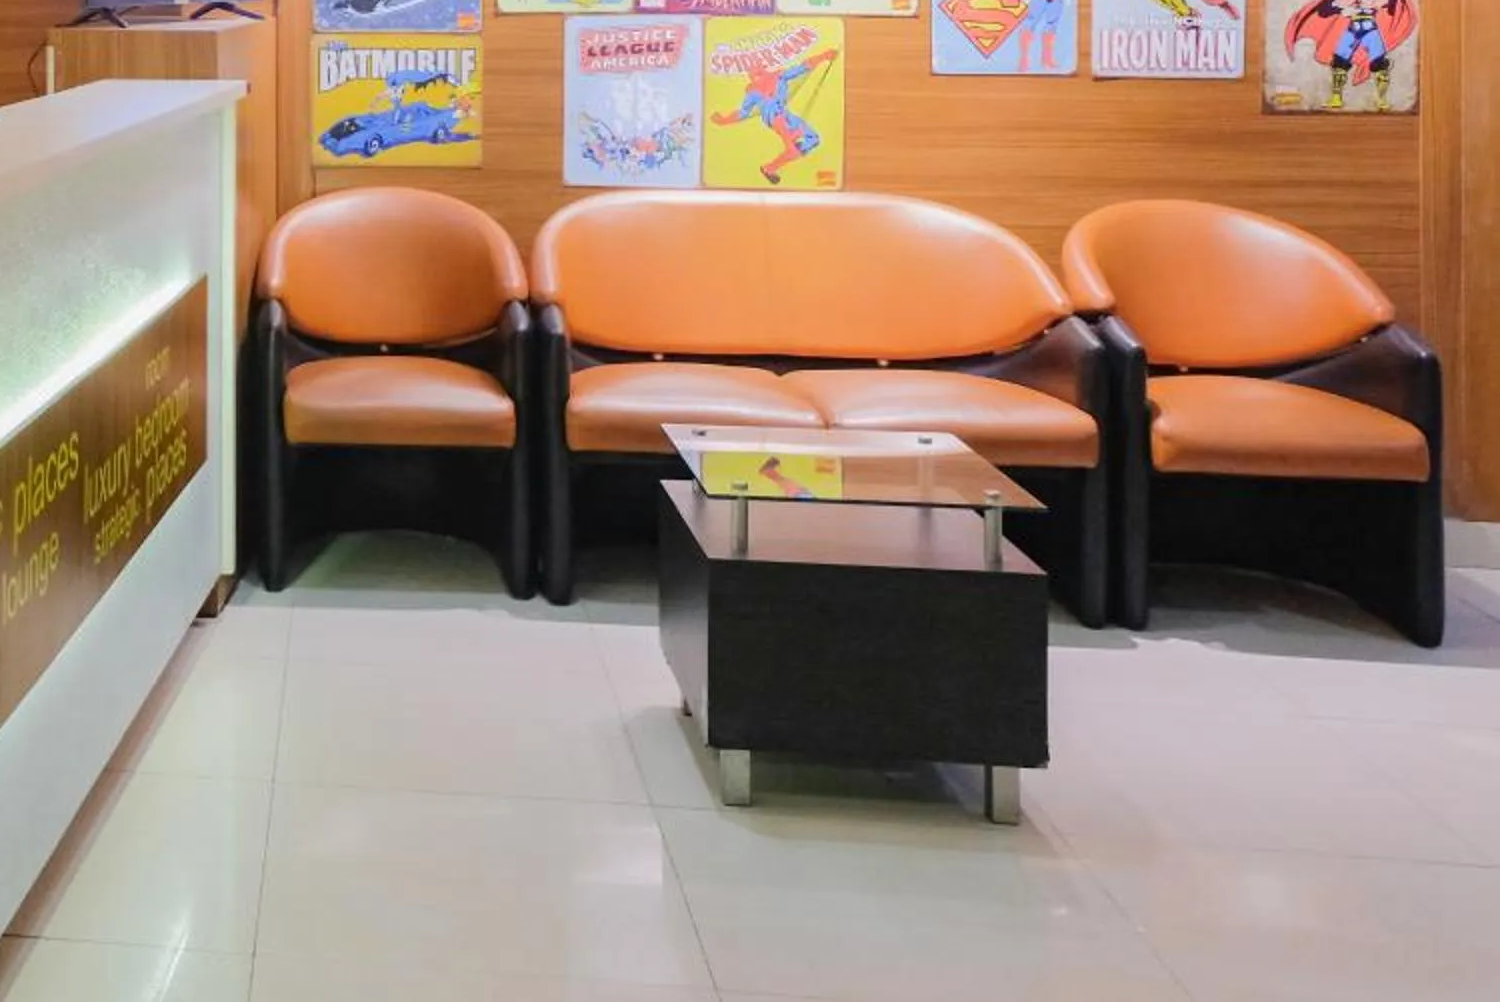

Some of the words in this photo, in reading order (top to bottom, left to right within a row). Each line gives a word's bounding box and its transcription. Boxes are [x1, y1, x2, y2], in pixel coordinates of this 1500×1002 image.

[586, 28, 678, 44] JUSTICE
[586, 41, 676, 58] LEAGUE
[1100, 29, 1169, 71] IRON
[1173, 27, 1238, 72] MAN
[13, 431, 80, 558] places
[83, 438, 132, 526] luxury
[2, 531, 60, 626] lounge
